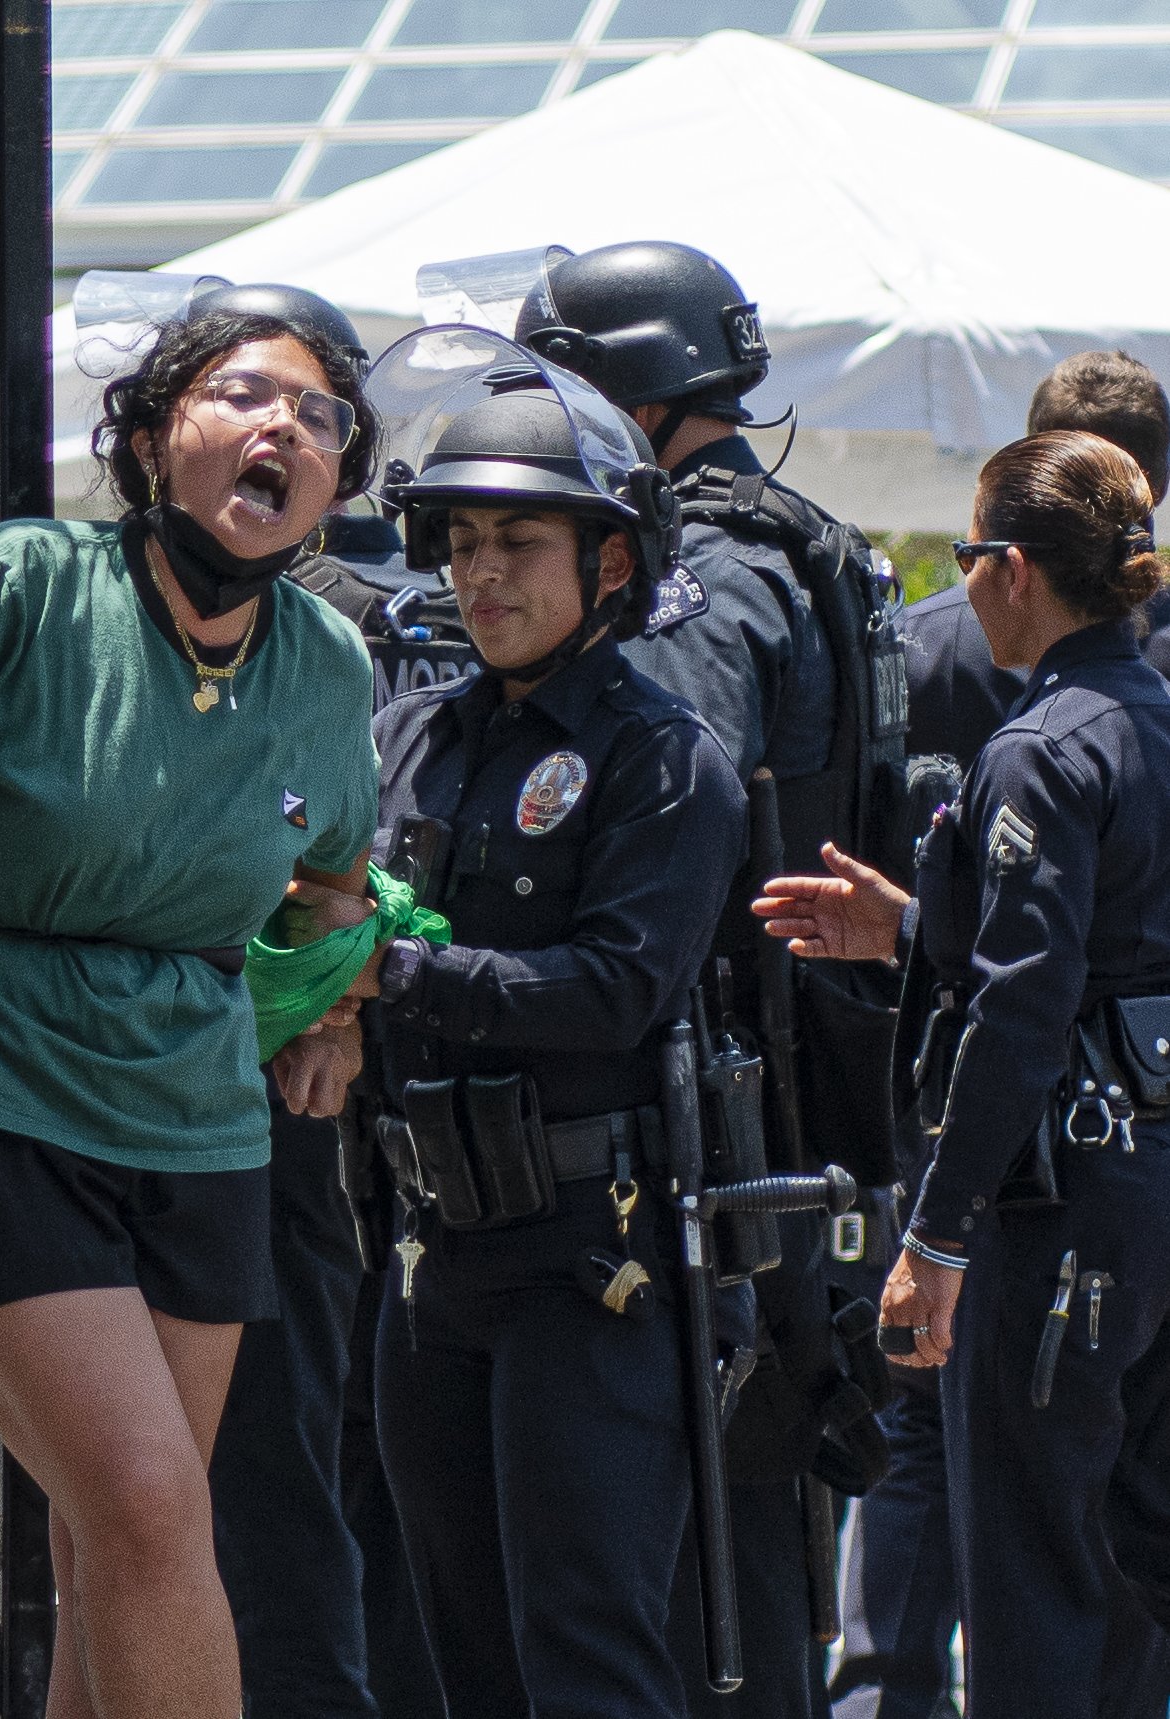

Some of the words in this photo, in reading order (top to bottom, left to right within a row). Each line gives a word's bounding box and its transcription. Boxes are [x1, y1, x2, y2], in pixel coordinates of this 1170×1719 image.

[660, 587, 680, 598] RO
[674, 568, 703, 603] ELES
[649, 602, 682, 624] LICE
